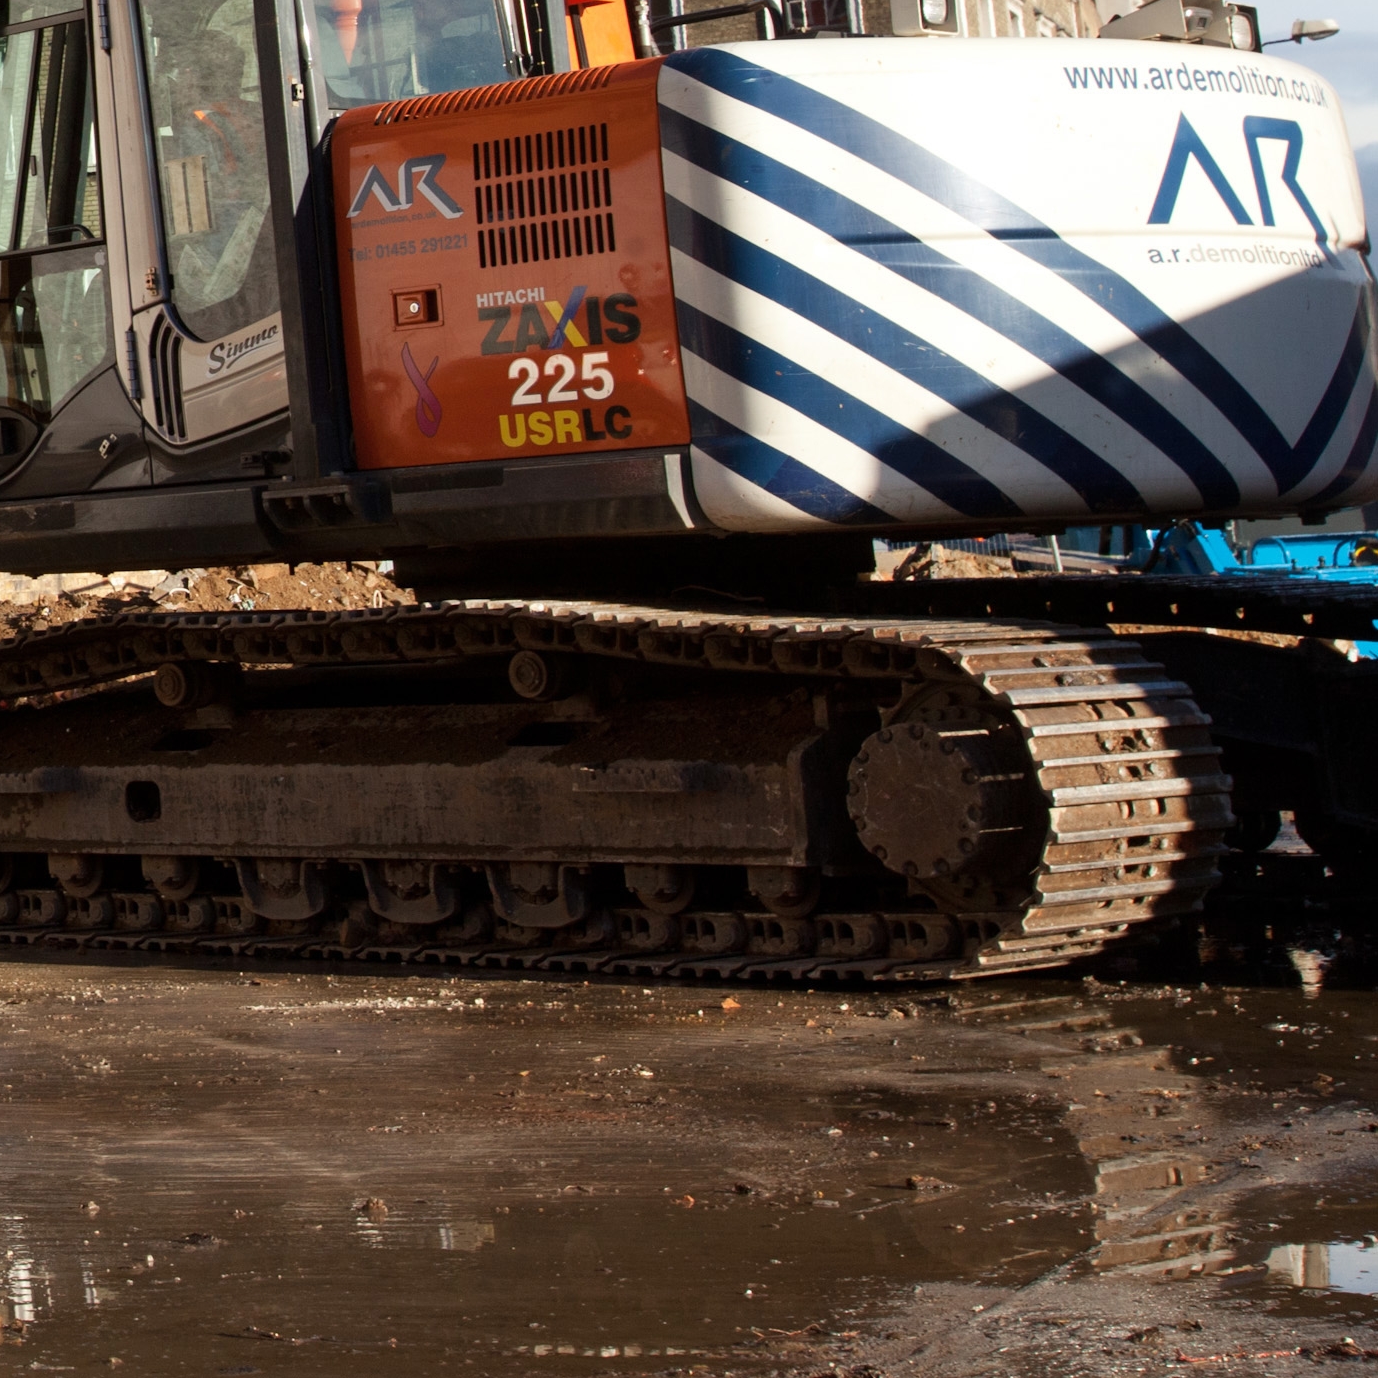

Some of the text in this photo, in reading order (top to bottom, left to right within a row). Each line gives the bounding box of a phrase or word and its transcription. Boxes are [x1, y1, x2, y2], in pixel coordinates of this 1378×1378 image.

[1063, 62, 1329, 108] www.ardemolition.co.uk
[346, 153, 464, 220] AR
[1146, 110, 1344, 271] AR
[349, 233, 468, 263] Tel: 01455 291221
[476, 286, 545, 308] HITACHI
[478, 285, 642, 356] ZAXIS
[207, 324, 279, 375] Simmo
[508, 351, 615, 407] 225
[498, 405, 633, 448] USRLC
